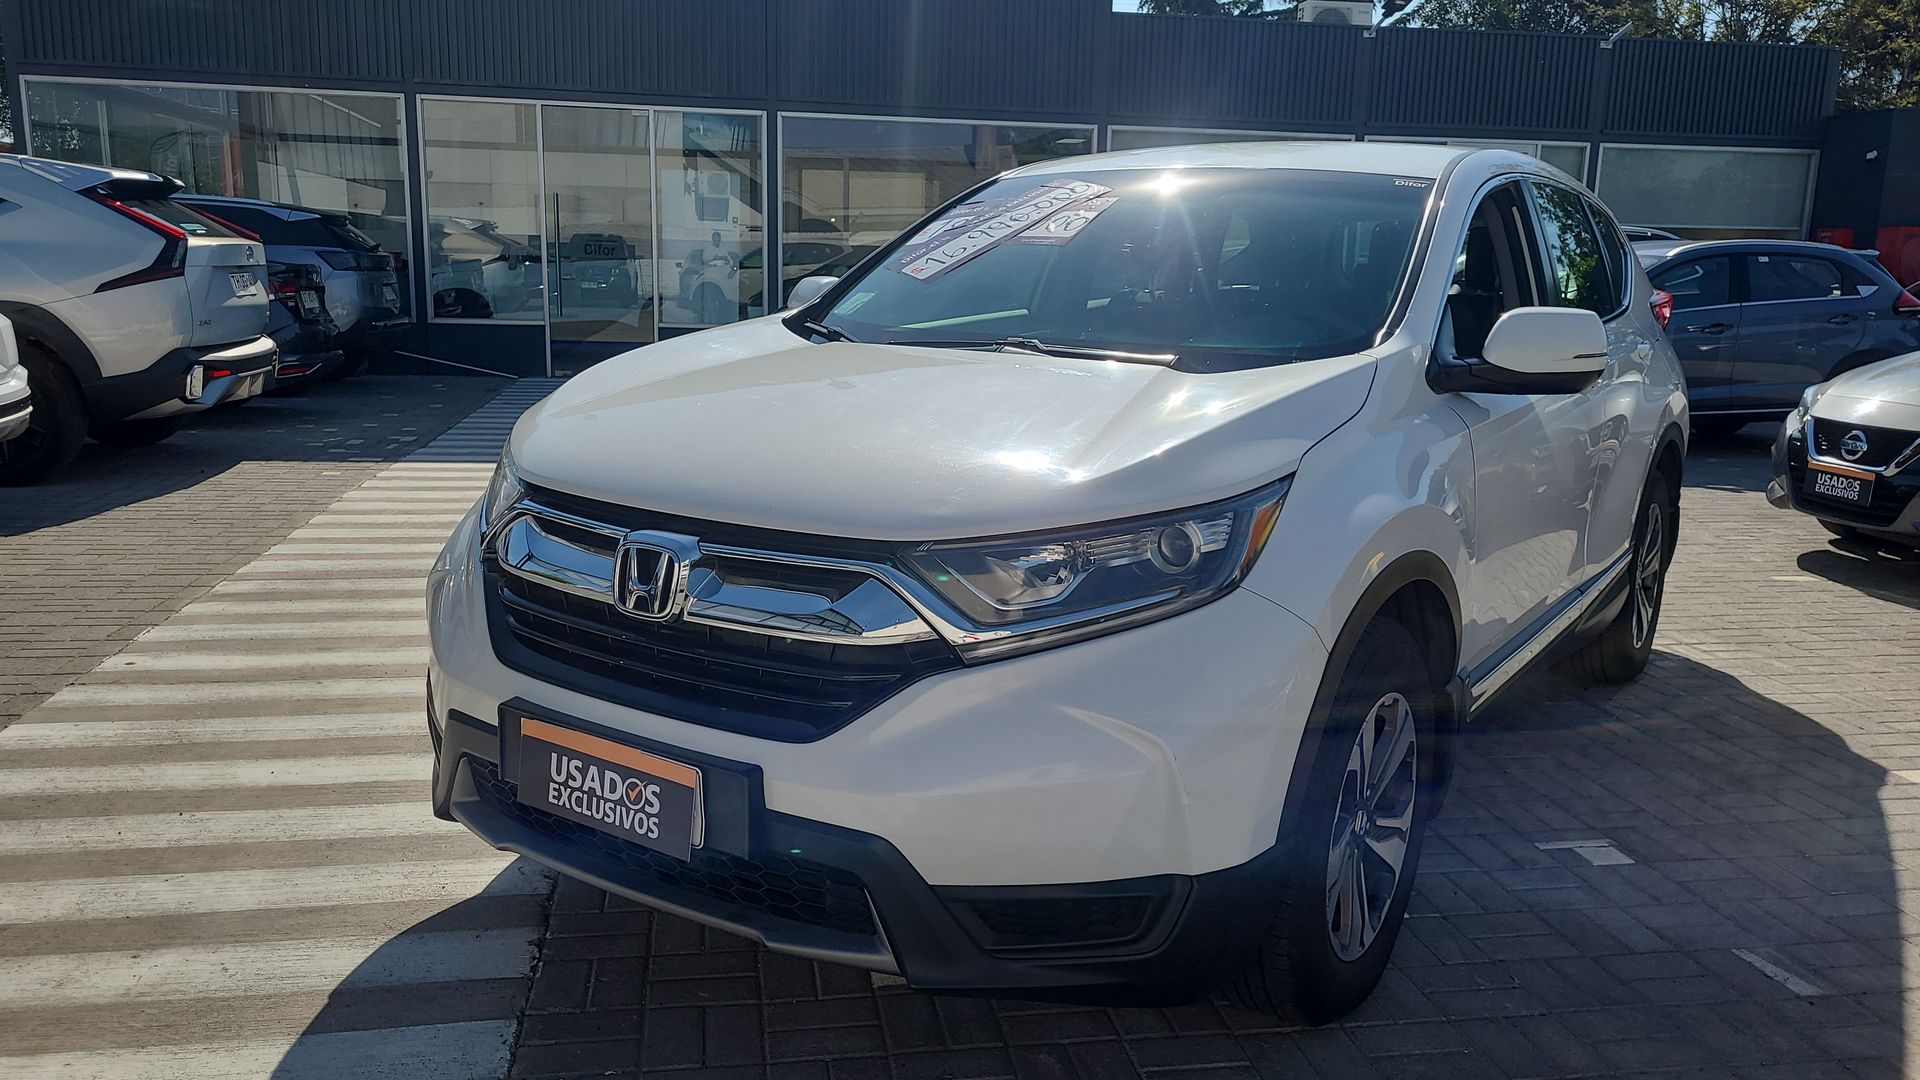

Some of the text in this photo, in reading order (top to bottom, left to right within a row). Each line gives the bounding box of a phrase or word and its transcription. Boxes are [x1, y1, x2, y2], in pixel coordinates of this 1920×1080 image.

[1394, 180, 1428, 188] Difor
[584, 243, 616, 256] Difor
[1817, 473, 1861, 491] USADOS
[1815, 483, 1859, 500] EXCLUSIVOS
[550, 752, 661, 814] USADOS
[549, 782, 659, 839] EXCLUSIVOS
